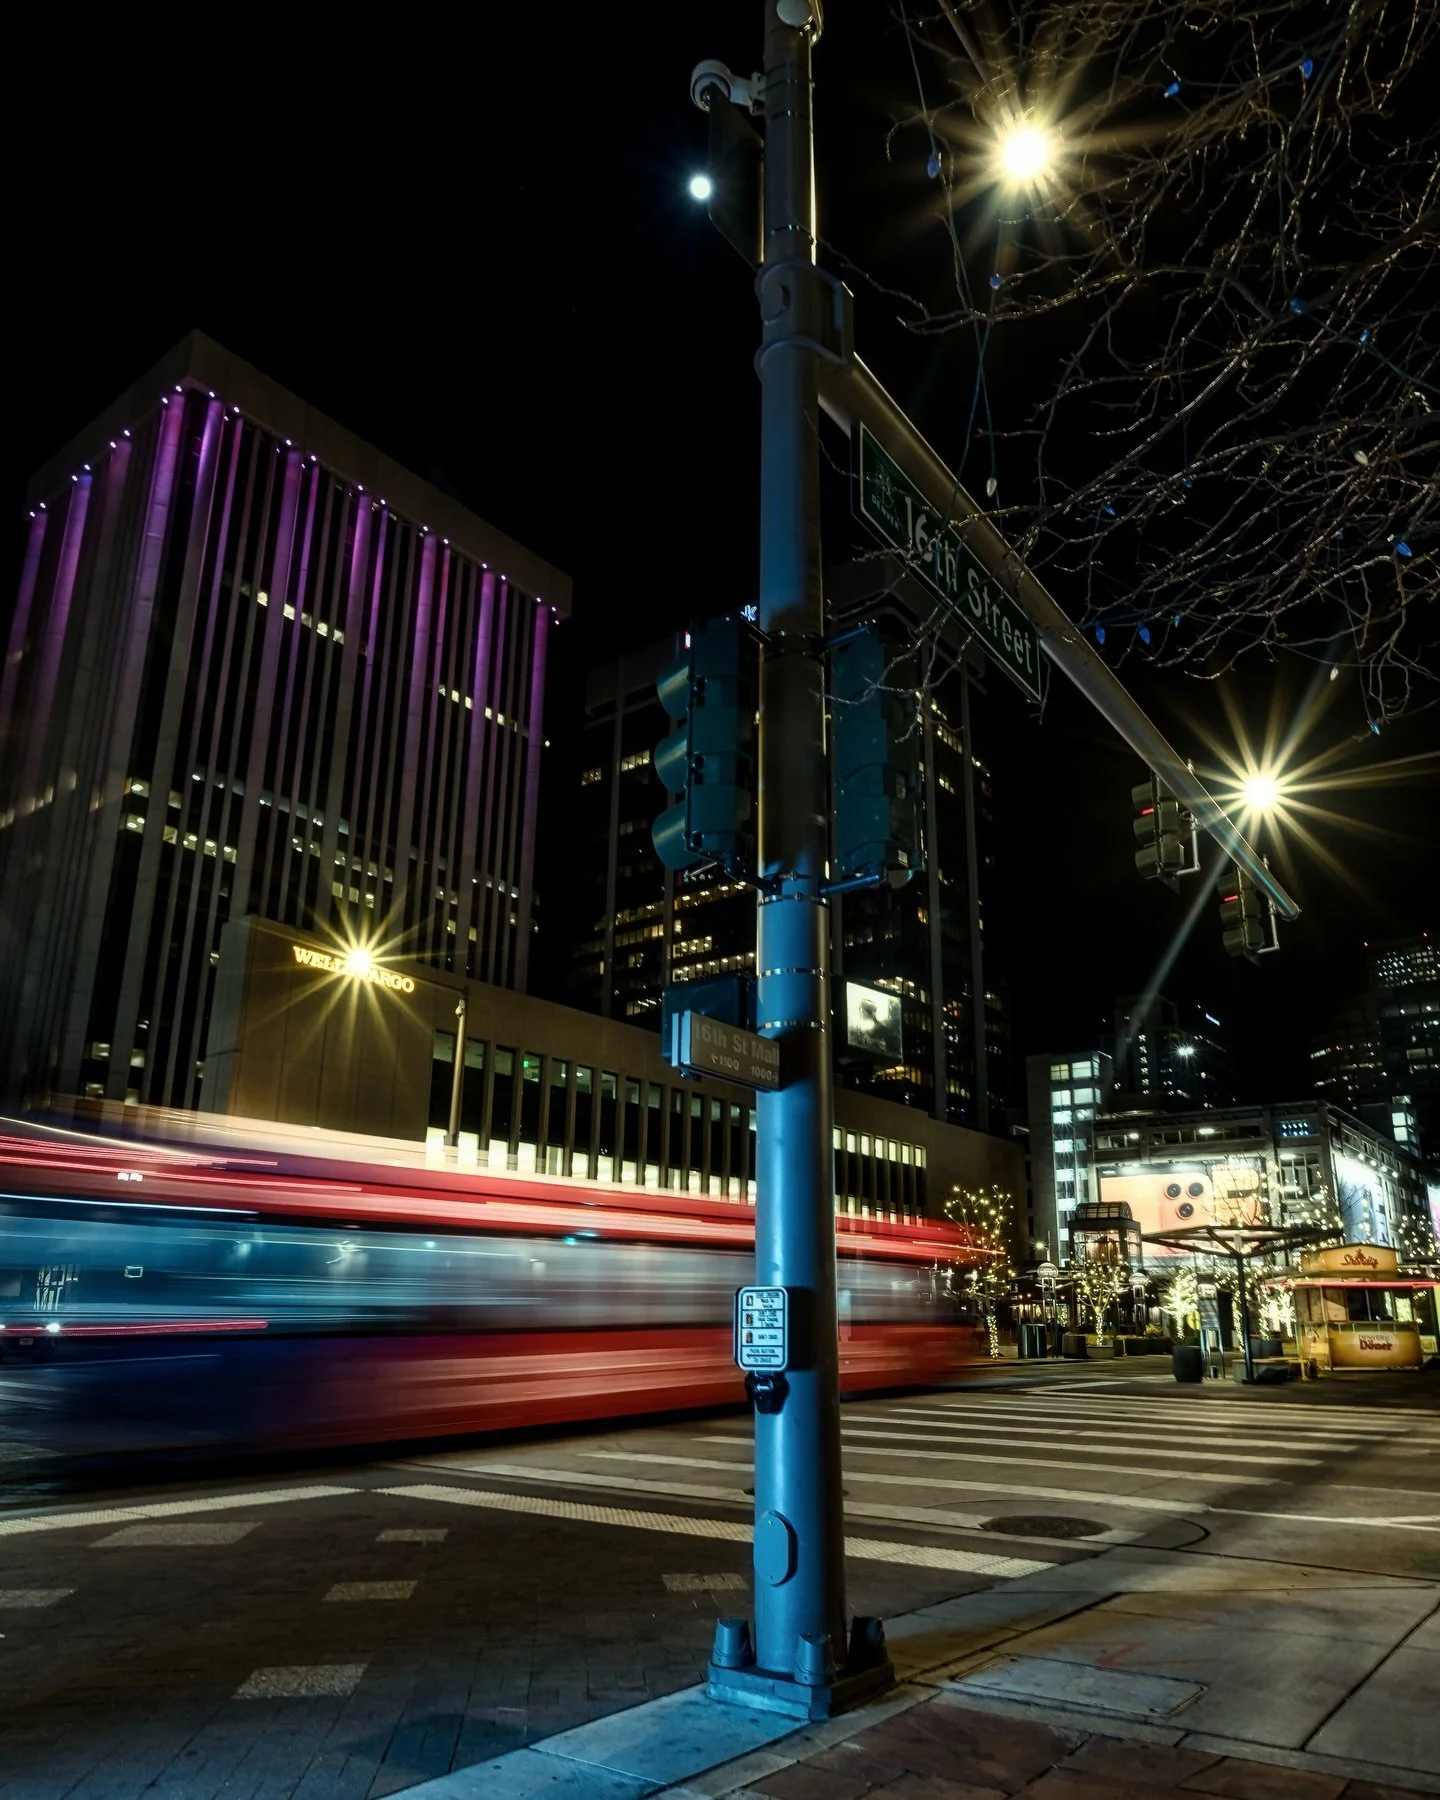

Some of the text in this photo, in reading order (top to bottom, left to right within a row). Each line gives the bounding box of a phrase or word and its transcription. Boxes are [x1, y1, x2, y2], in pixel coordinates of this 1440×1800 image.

[905, 496, 1033, 675] 16th Street
[293, 945, 350, 976] WELL
[695, 1020, 780, 1066] 16th St Mall
